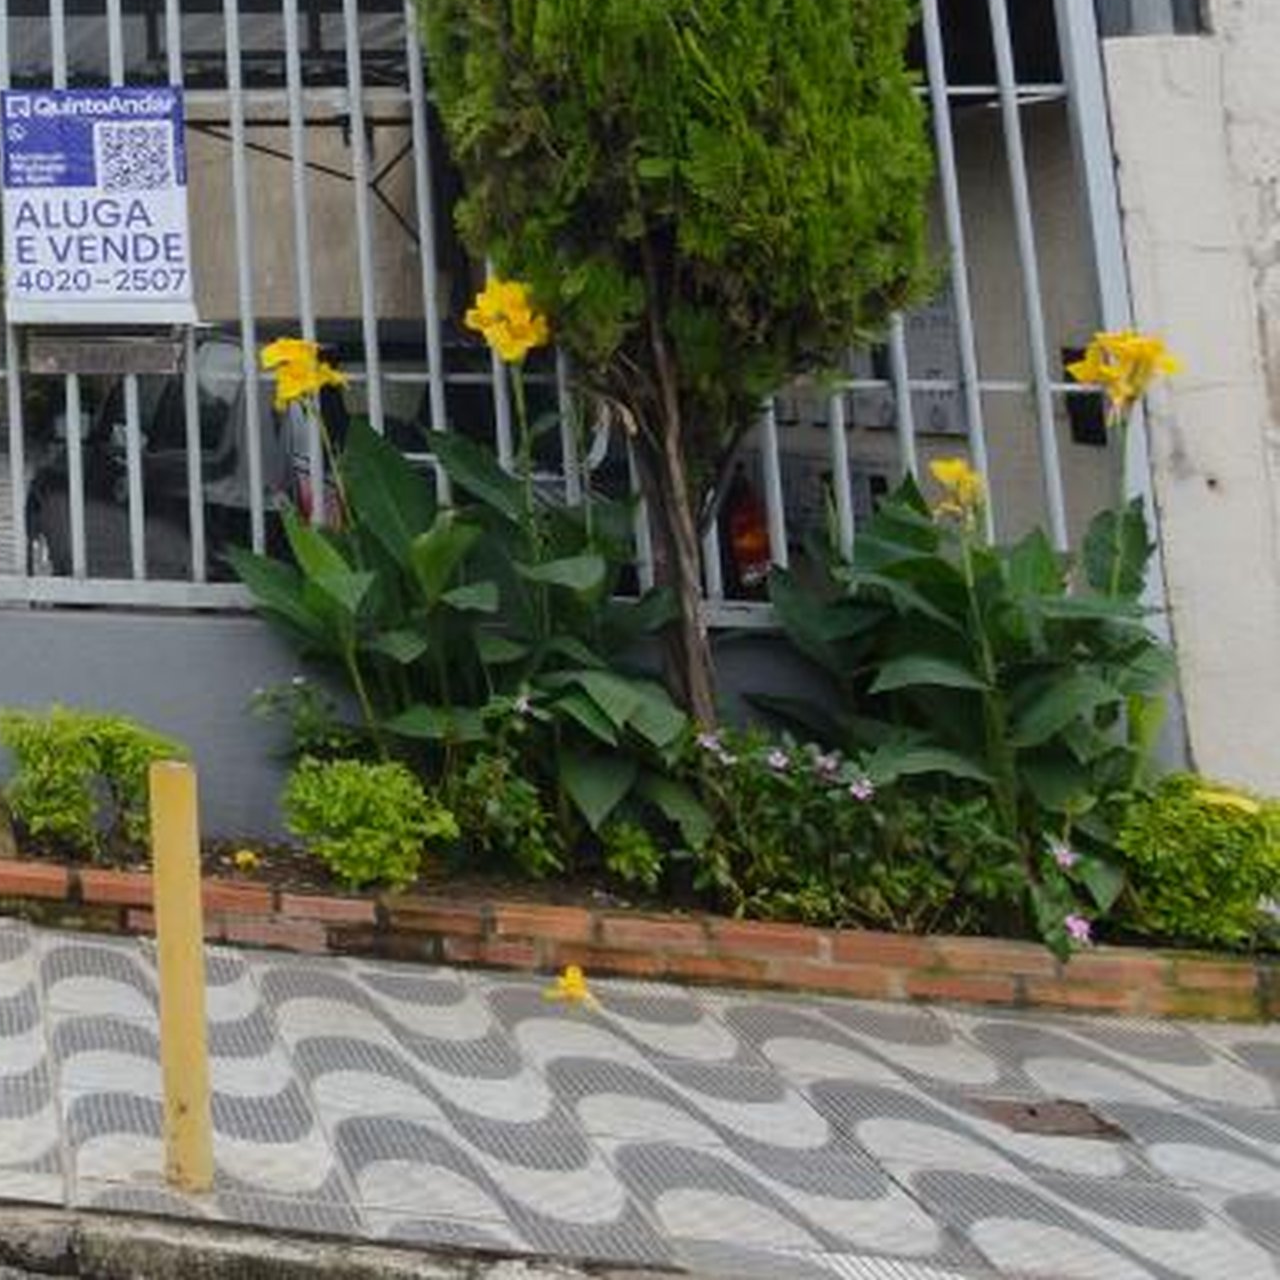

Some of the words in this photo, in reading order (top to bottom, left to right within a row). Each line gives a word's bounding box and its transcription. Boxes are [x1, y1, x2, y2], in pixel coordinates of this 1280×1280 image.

[33, 94, 177, 117] QuintoAndar
[14, 198, 153, 229] ALUGA
[16, 236, 37, 264] E
[48, 233, 184, 264] VENDE
